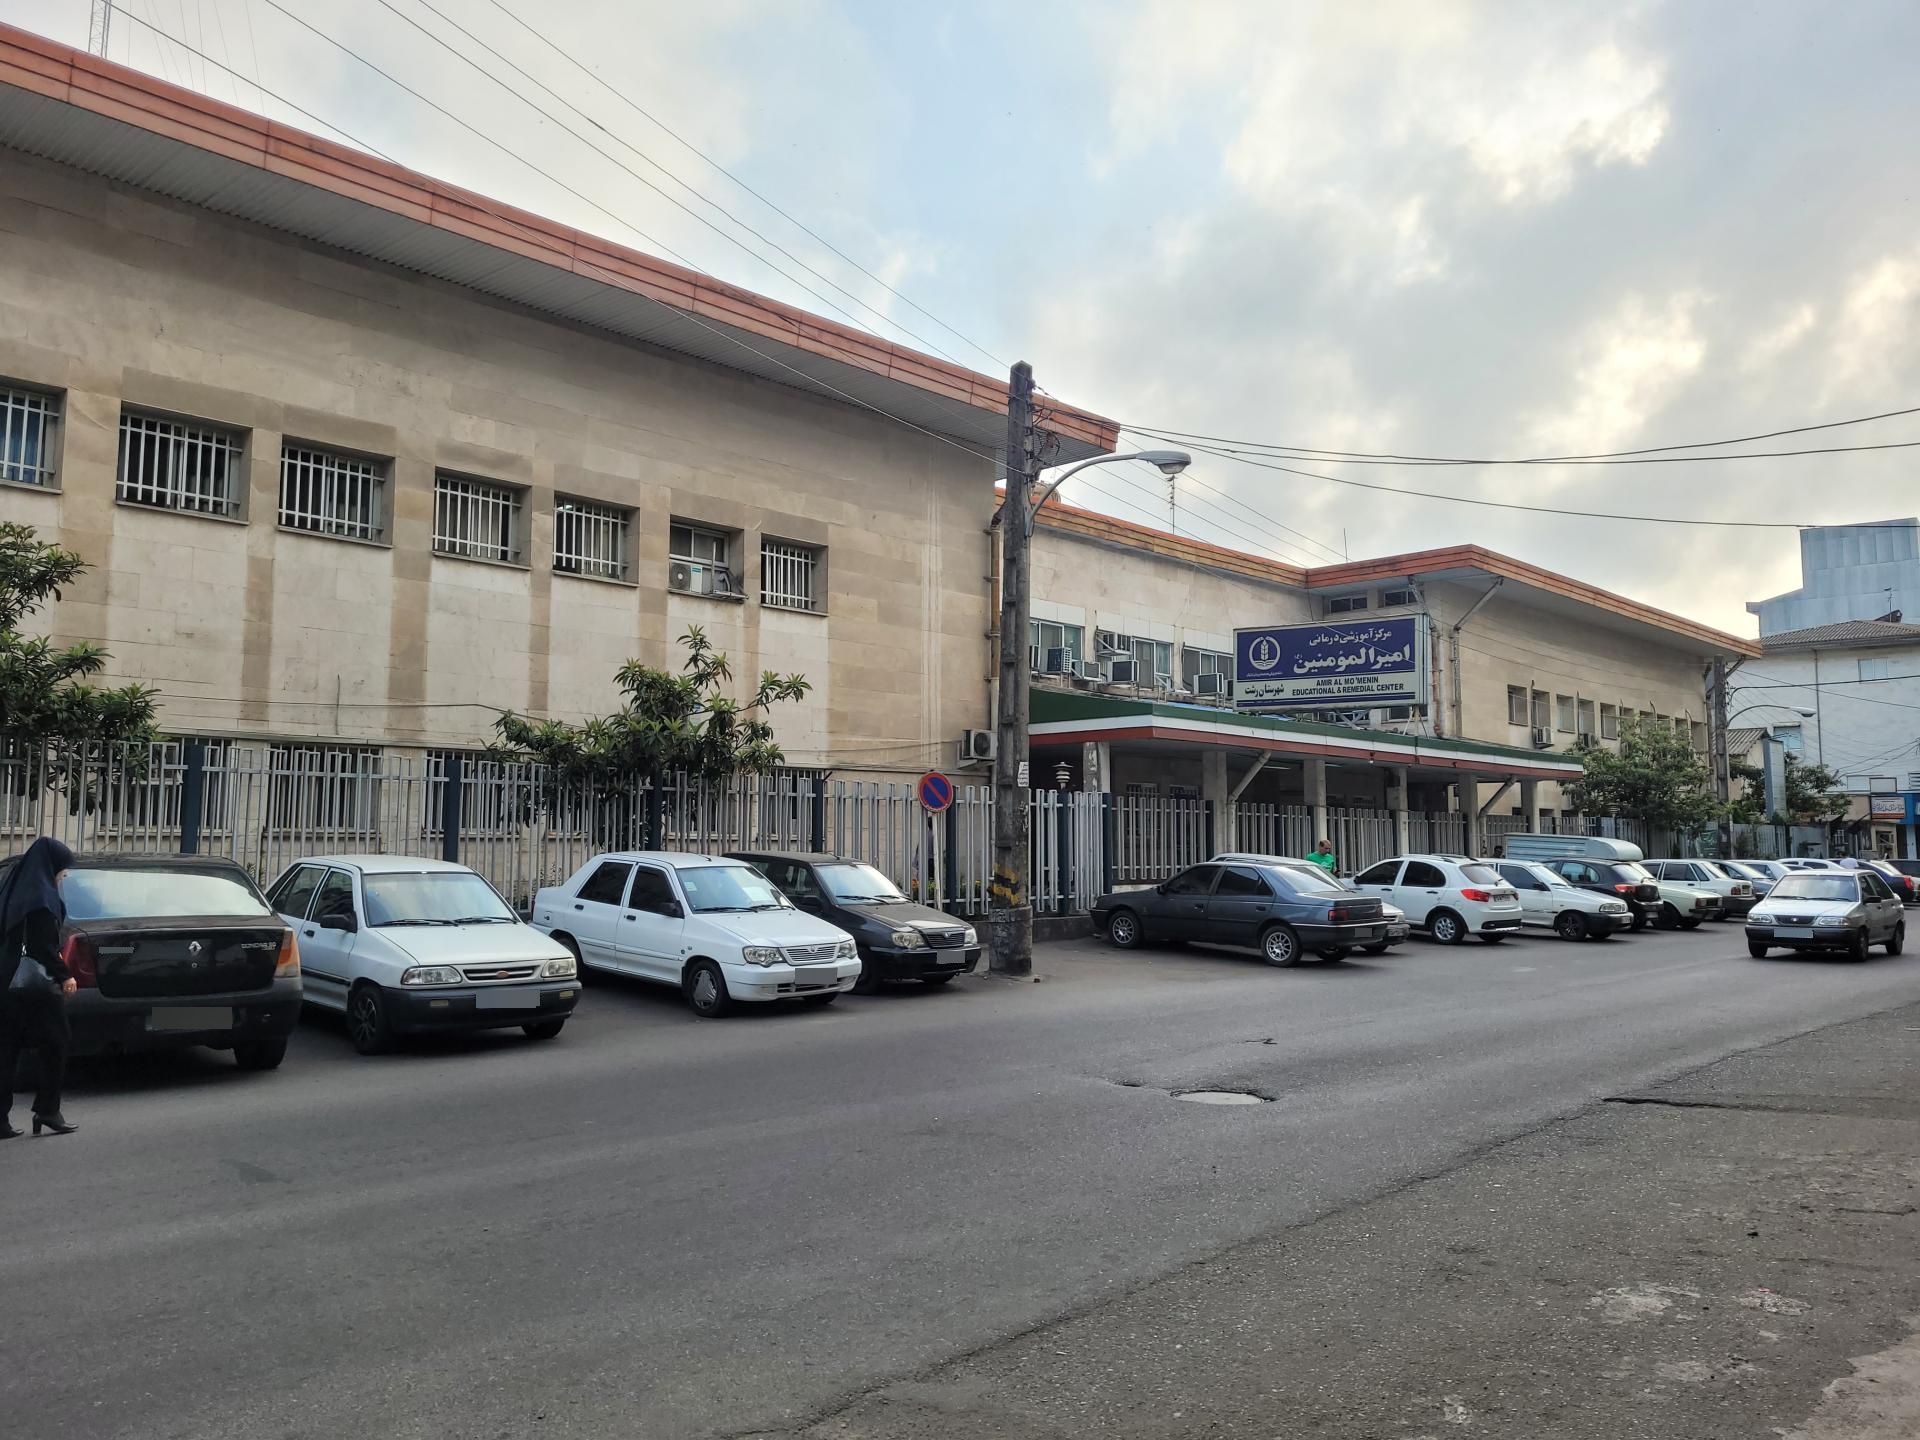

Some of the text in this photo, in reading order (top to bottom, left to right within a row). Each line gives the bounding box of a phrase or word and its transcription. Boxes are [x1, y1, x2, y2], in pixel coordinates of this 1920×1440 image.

[1309, 627, 1393, 646] مرکز آموزشی درمانی
[1292, 683, 1404, 696] EDUCATIONAL & REMEDIAL CENTER
[1316, 679, 1333, 687] AMIR
[1334, 678, 1343, 686] AL
[1244, 683, 1285, 698] شهرستان رشت
